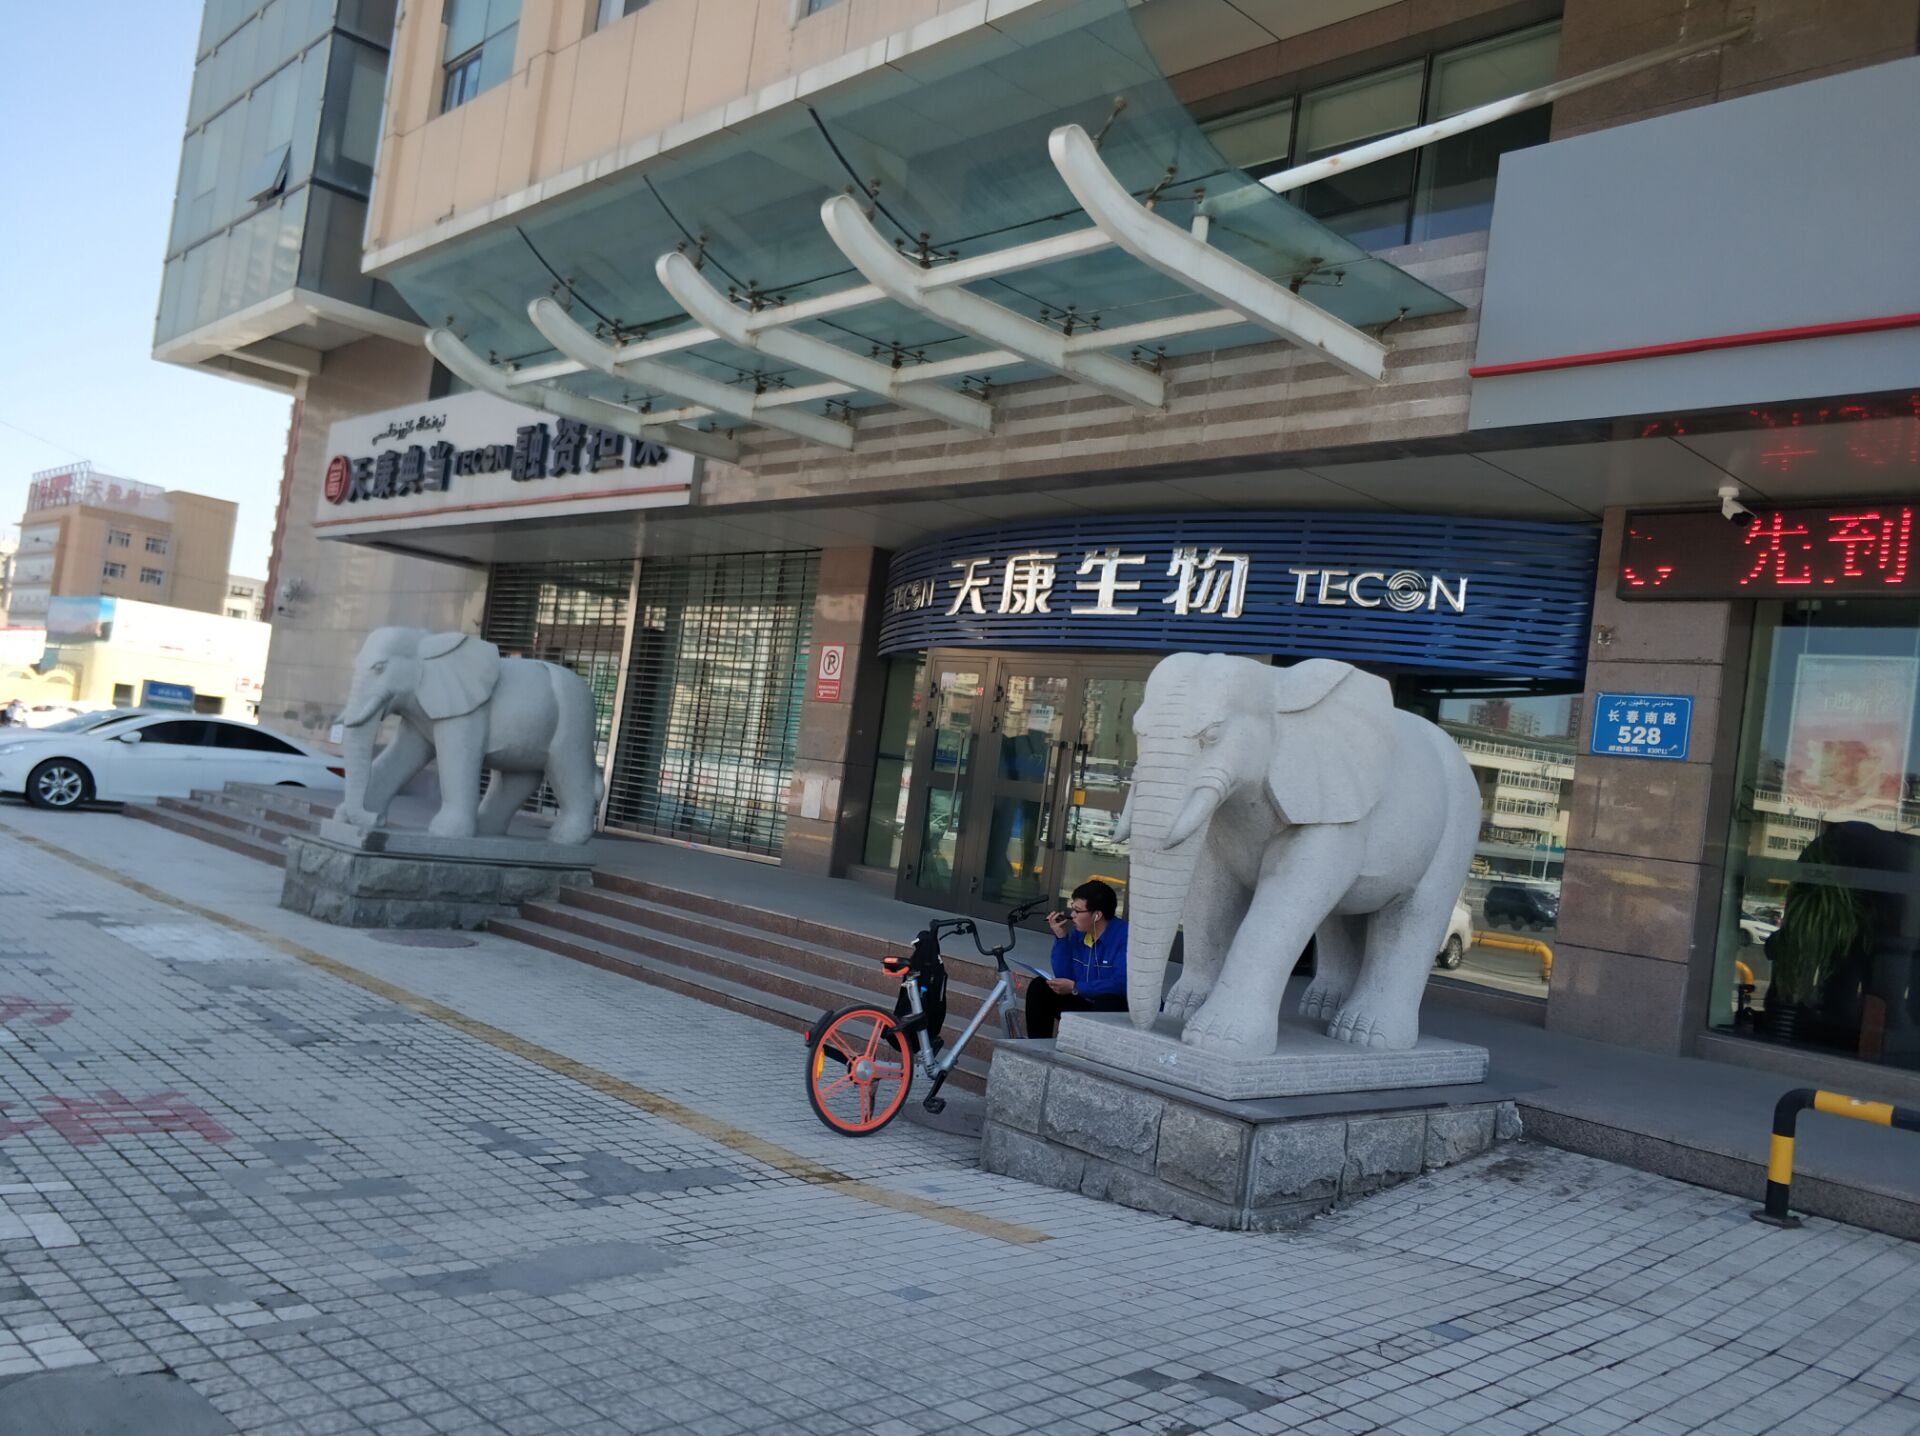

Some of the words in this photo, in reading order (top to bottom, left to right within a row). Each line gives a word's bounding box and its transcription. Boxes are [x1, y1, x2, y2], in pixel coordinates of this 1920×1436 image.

[347, 441, 454, 502] 天康典当
[1737, 505, 1914, 585] 先到
[944, 546, 1250, 618] 天康生物
[1288, 567, 1469, 614] TECON
[1608, 709, 1677, 725] 长春南路
[1617, 726, 1661, 745] 528
